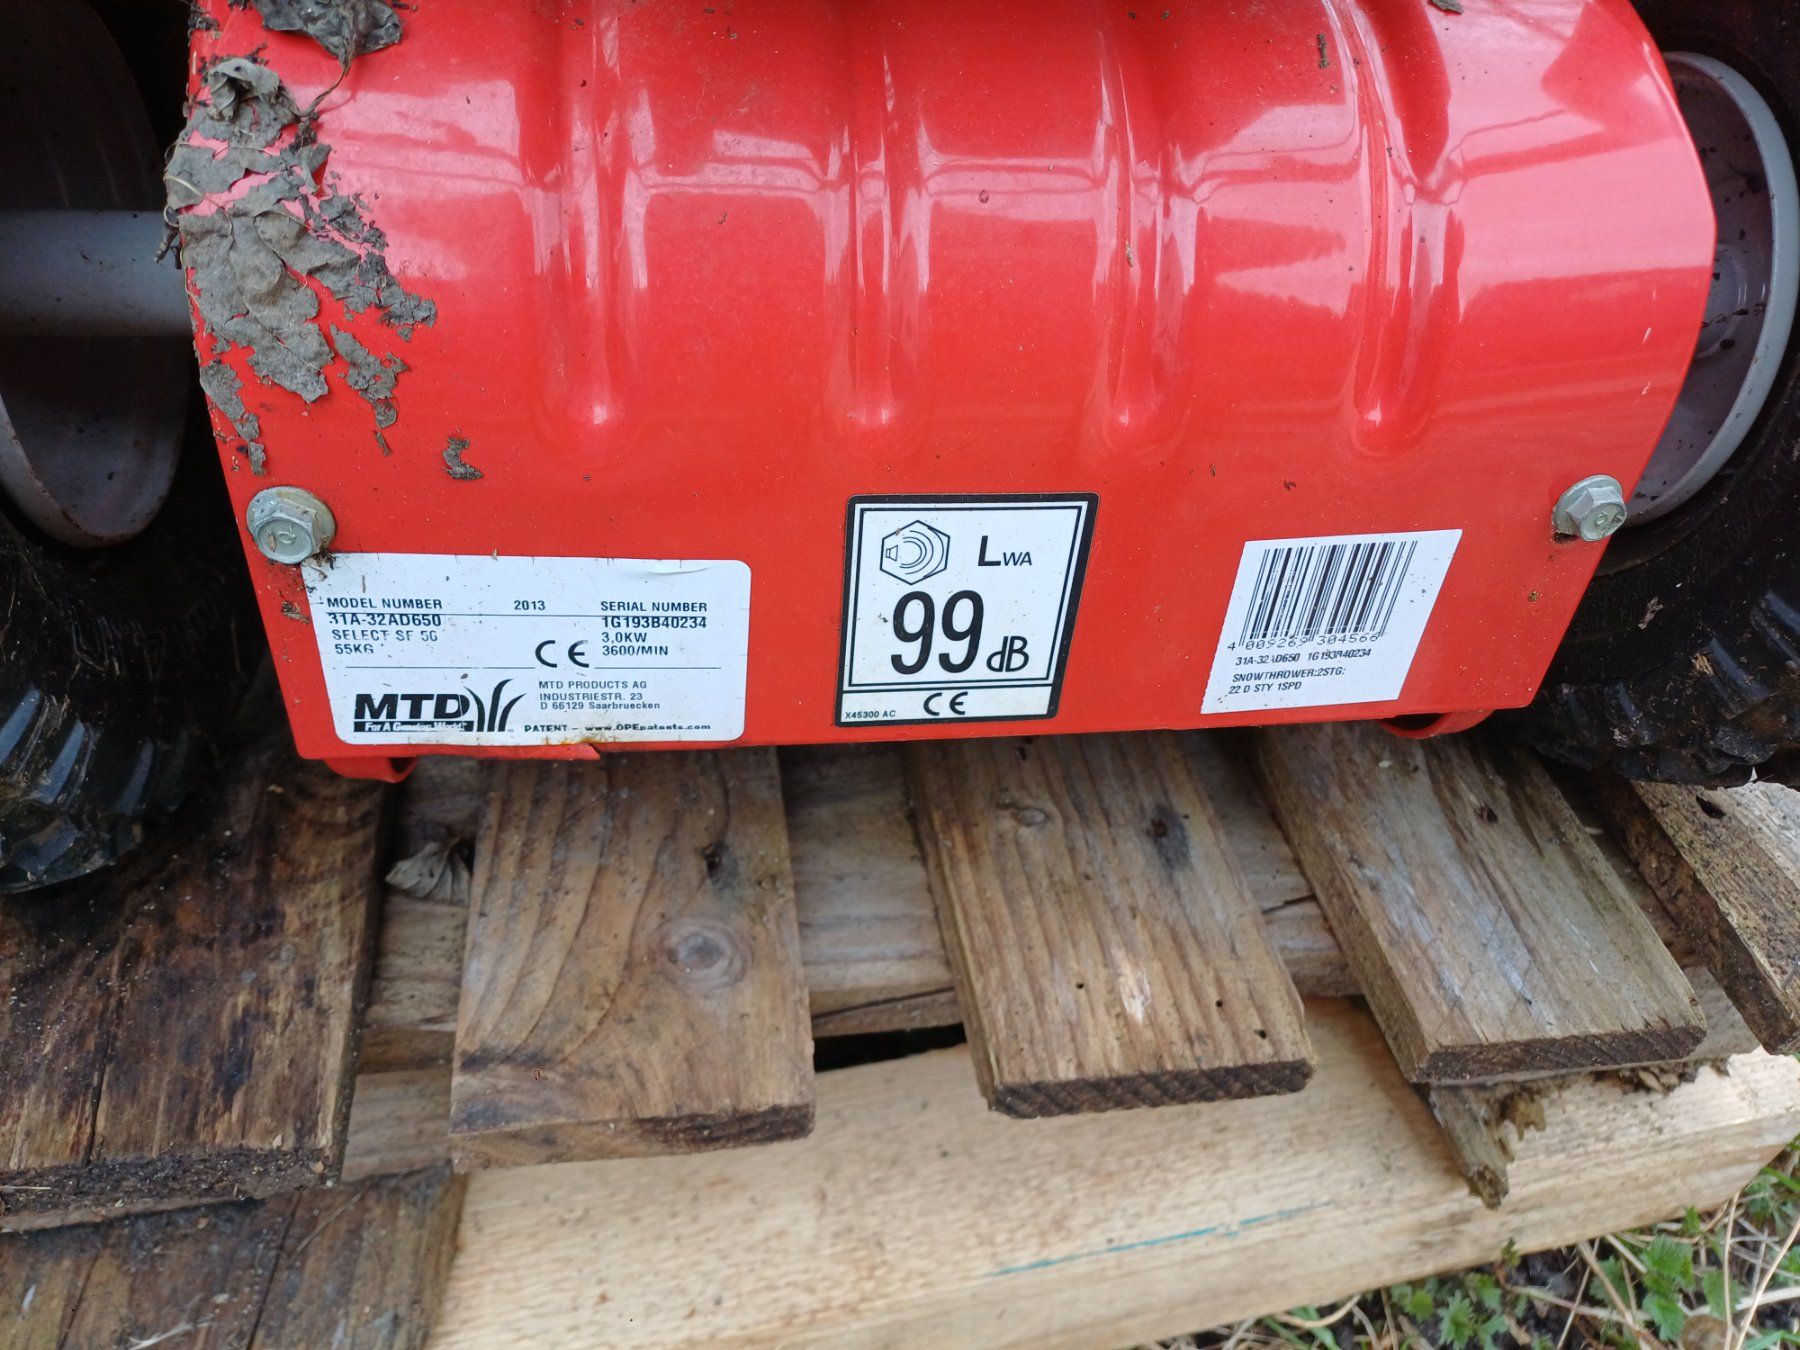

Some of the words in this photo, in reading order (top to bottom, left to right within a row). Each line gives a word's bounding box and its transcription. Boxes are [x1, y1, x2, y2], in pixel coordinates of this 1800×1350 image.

[326, 597, 377, 609] MODEL
[382, 598, 443, 610] NUMBER
[513, 600, 546, 611] 2013
[600, 600, 647, 612] SERIAL
[651, 601, 708, 612] NUMBER
[328, 613, 442, 627] 31A-32AD650
[602, 616, 708, 629] 1G193B40234
[331, 629, 389, 642] SELECT
[395, 630, 414, 642] SF
[601, 632, 648, 644] 3,0KW
[890, 590, 984, 675] 99
[986, 635, 1030, 673] dB
[334, 643, 375, 655] 55KG
[602, 645, 669, 656] 3600/MIN
[1227, 641, 1237, 651] 4
[538, 680, 564, 690] MTD
[567, 680, 629, 690] PRODUCTS
[632, 680, 648, 690] AG
[1228, 685, 1242, 695] 22
[1243, 684, 1251, 694] D
[1253, 682, 1273, 693] STY
[1277, 681, 1302, 691] 1SPD
[539, 692, 627, 702] INDUSTRIESTR.
[630, 692, 644, 701] 23
[354, 693, 471, 720] MTD
[540, 702, 548, 710] D
[551, 702, 585, 710] 66129
[588, 701, 661, 711] Saarbruecken
[844, 710, 880, 719] X45300
[882, 709, 897, 718] AC
[364, 722, 383, 732] For
[523, 724, 568, 733] PATENT
